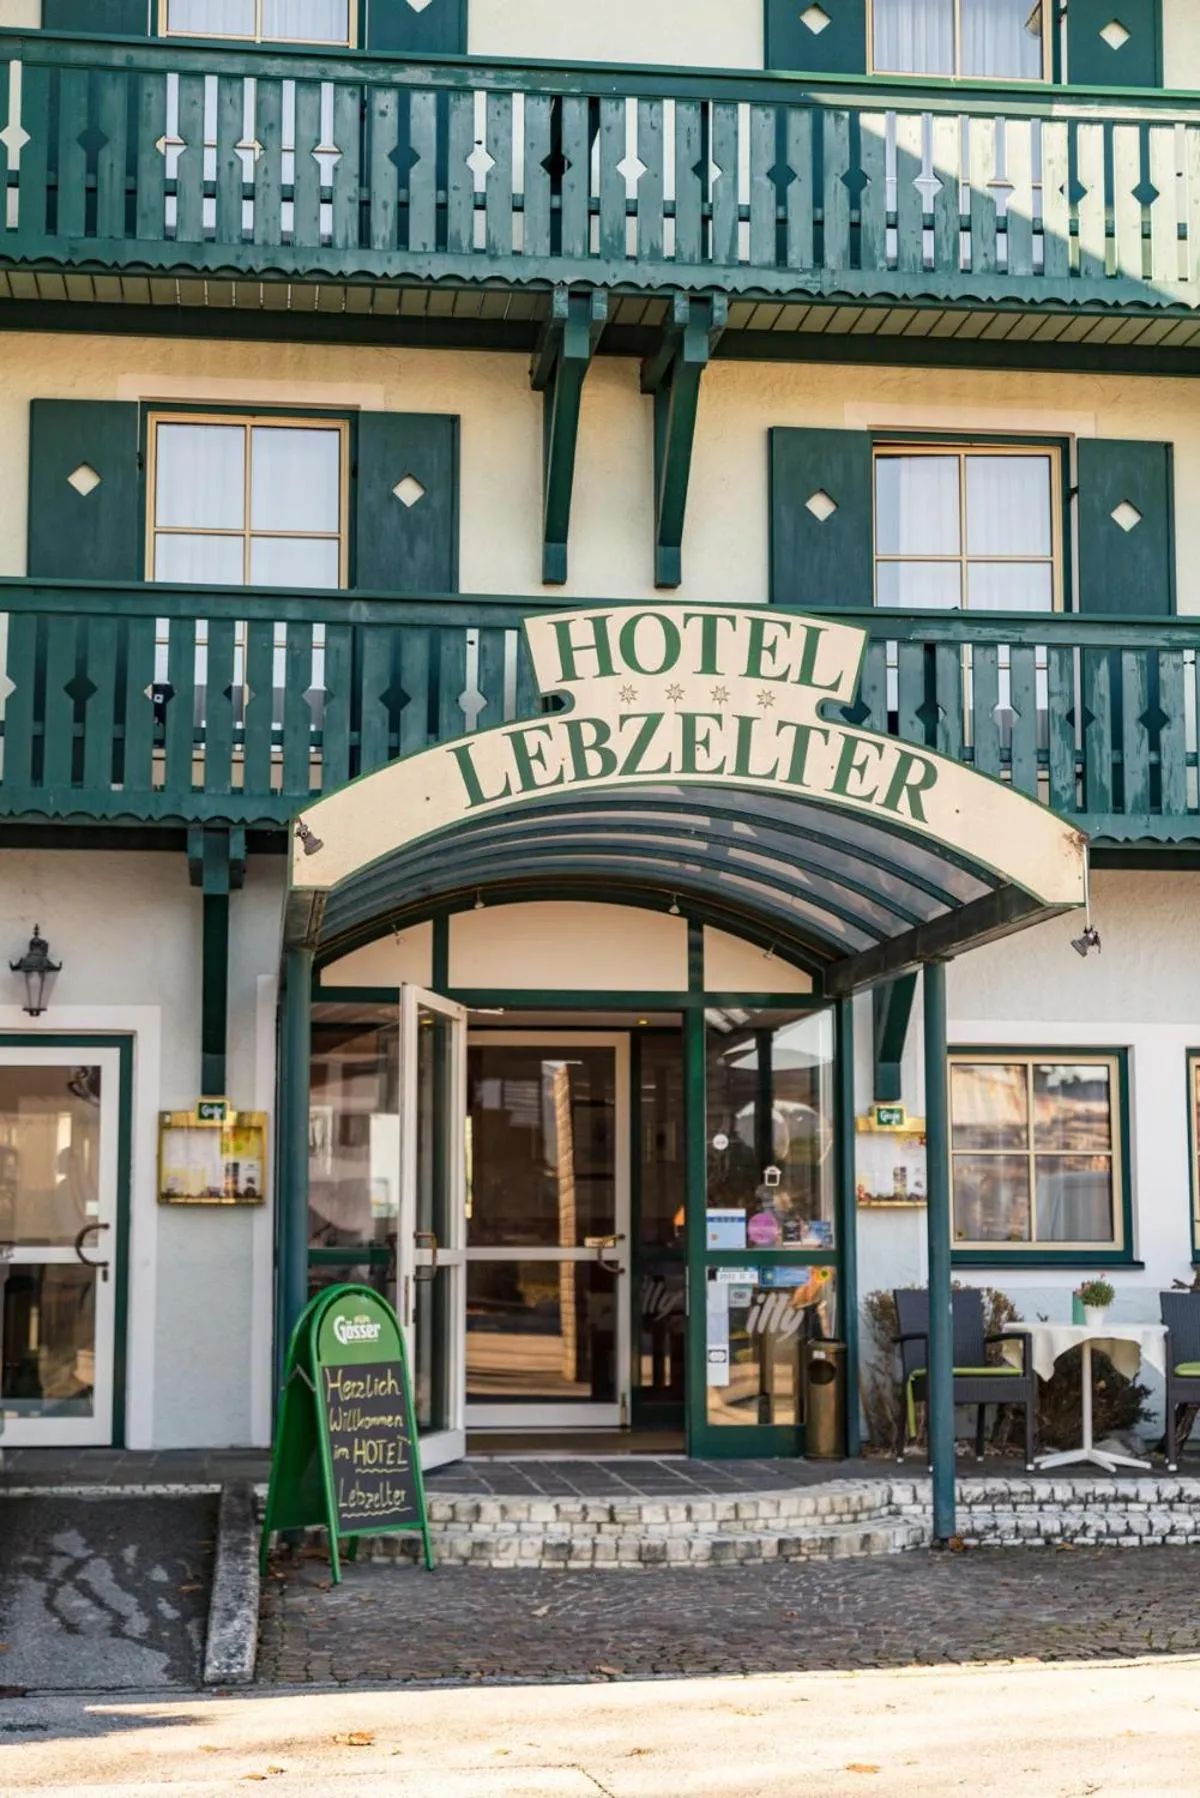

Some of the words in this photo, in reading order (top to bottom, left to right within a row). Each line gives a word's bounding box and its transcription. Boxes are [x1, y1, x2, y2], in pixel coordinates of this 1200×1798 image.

[547, 612, 844, 692] HOTEL
[446, 712, 938, 824] LEBZELTER
[333, 1315, 382, 1345] Gösser
[746, 1291, 805, 1342] illy
[324, 1367, 402, 1402] Herzlich
[329, 1406, 404, 1432] Willkommen
[353, 1436, 410, 1465] HOTEL
[338, 1478, 406, 1508] Lebzelter
